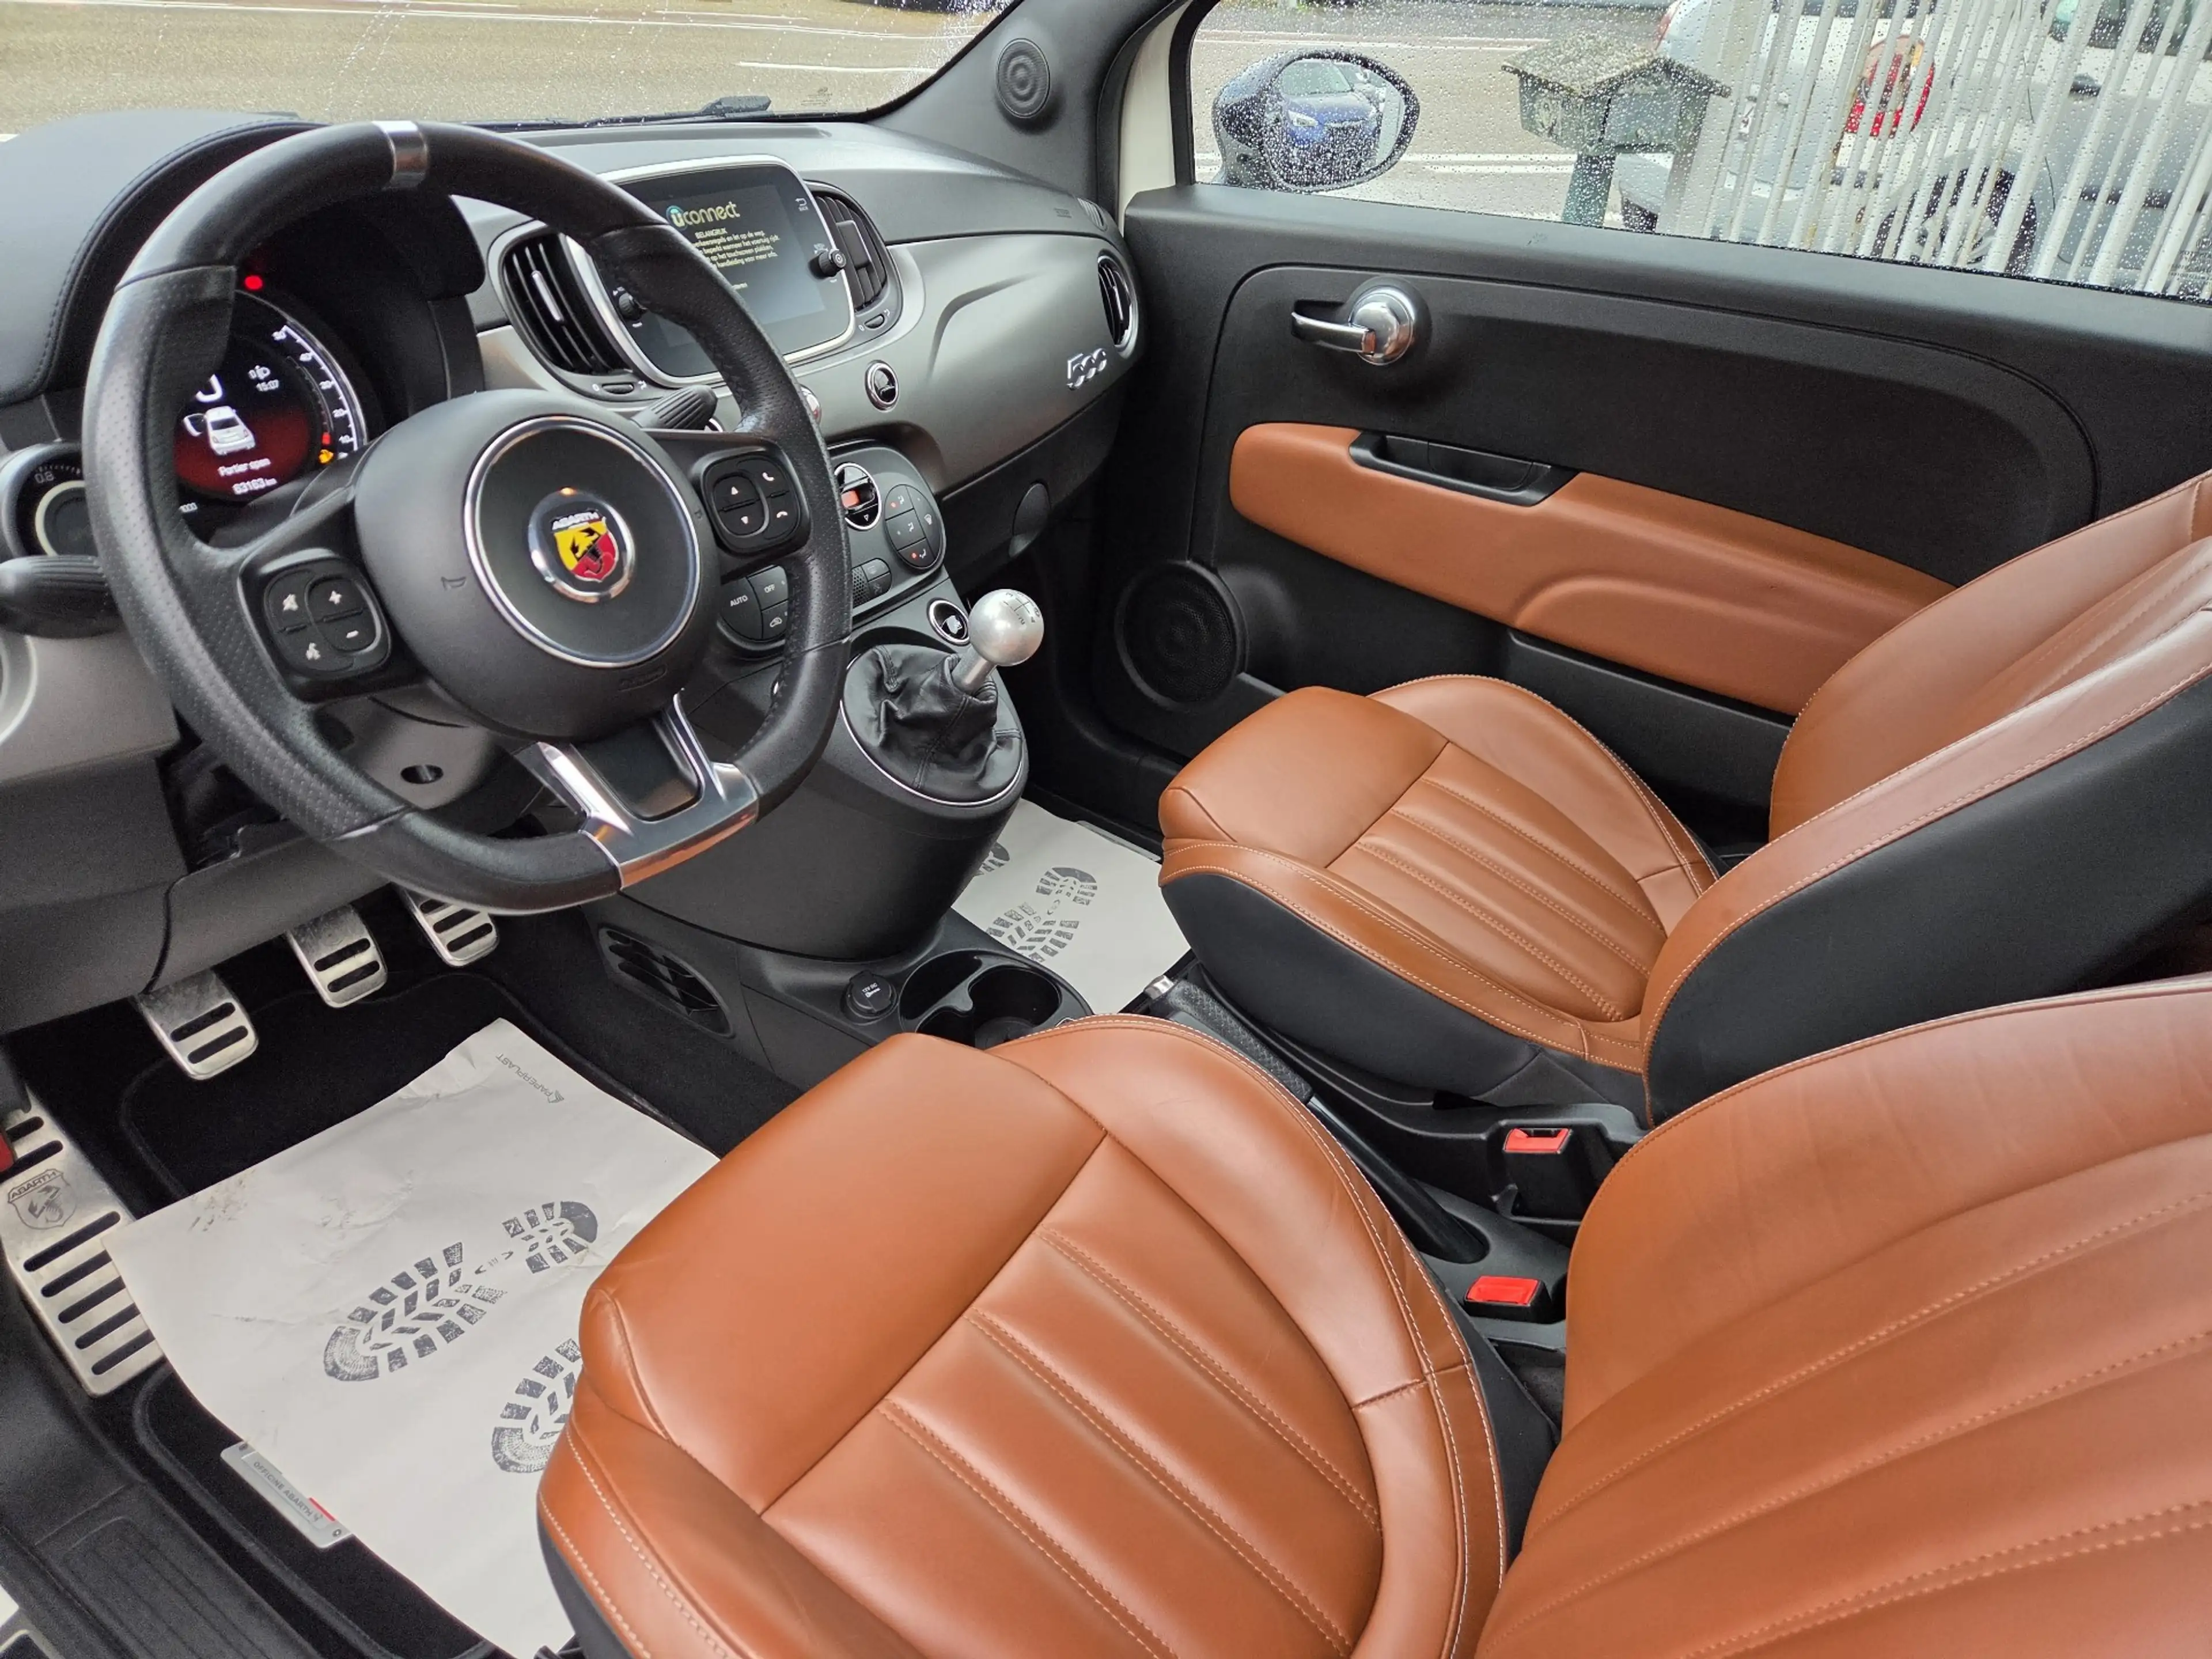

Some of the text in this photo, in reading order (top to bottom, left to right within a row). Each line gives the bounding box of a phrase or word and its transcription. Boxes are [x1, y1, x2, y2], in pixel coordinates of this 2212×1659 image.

[1066, 348, 1107, 391] 500
[730, 594, 748, 607] AUTO
[764, 584, 775, 593] OFF
[495, 1052, 554, 1097] PAPERPLAST
[11, 1171, 56, 1199] ABARTH
[253, 1461, 313, 1517] OFFICINE ABARTH
